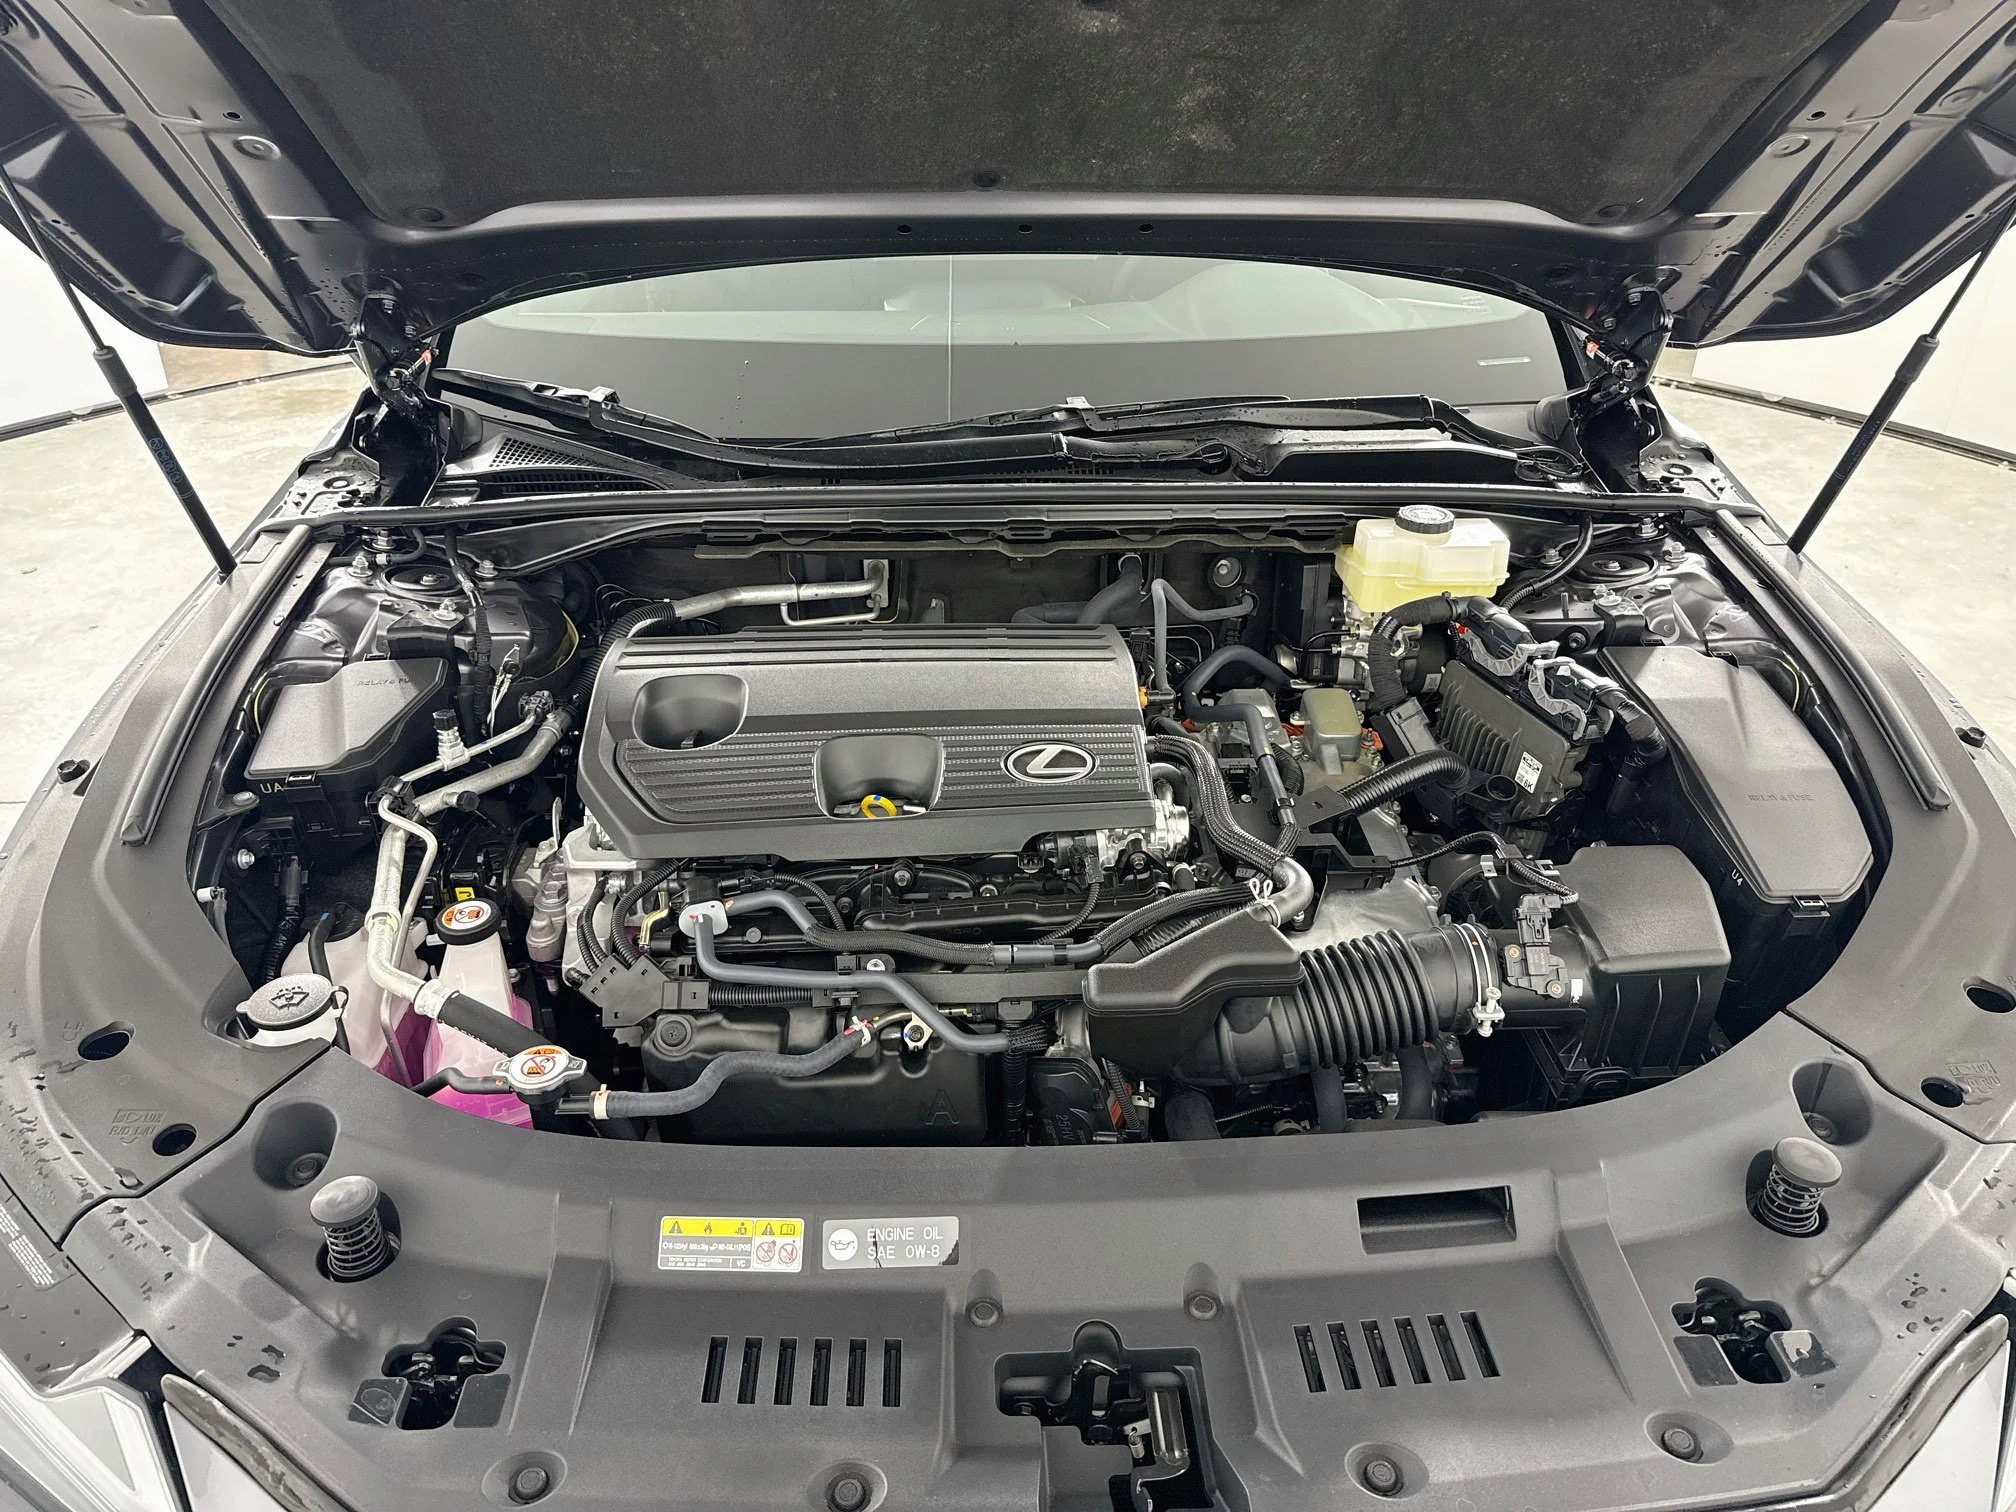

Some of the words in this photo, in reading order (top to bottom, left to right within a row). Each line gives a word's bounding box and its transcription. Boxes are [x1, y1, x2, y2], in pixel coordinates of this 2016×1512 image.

[1523, 779, 1534, 792] 6K
[1787, 793, 1814, 802] FUSE
[1055, 1114, 1076, 1141] 25HV
[867, 1227, 915, 1242] ENGINE
[923, 1226, 945, 1241] OIL
[867, 1245, 897, 1260] SAE
[905, 1244, 941, 1259] 0W-8
[736, 1259, 747, 1268] VC
